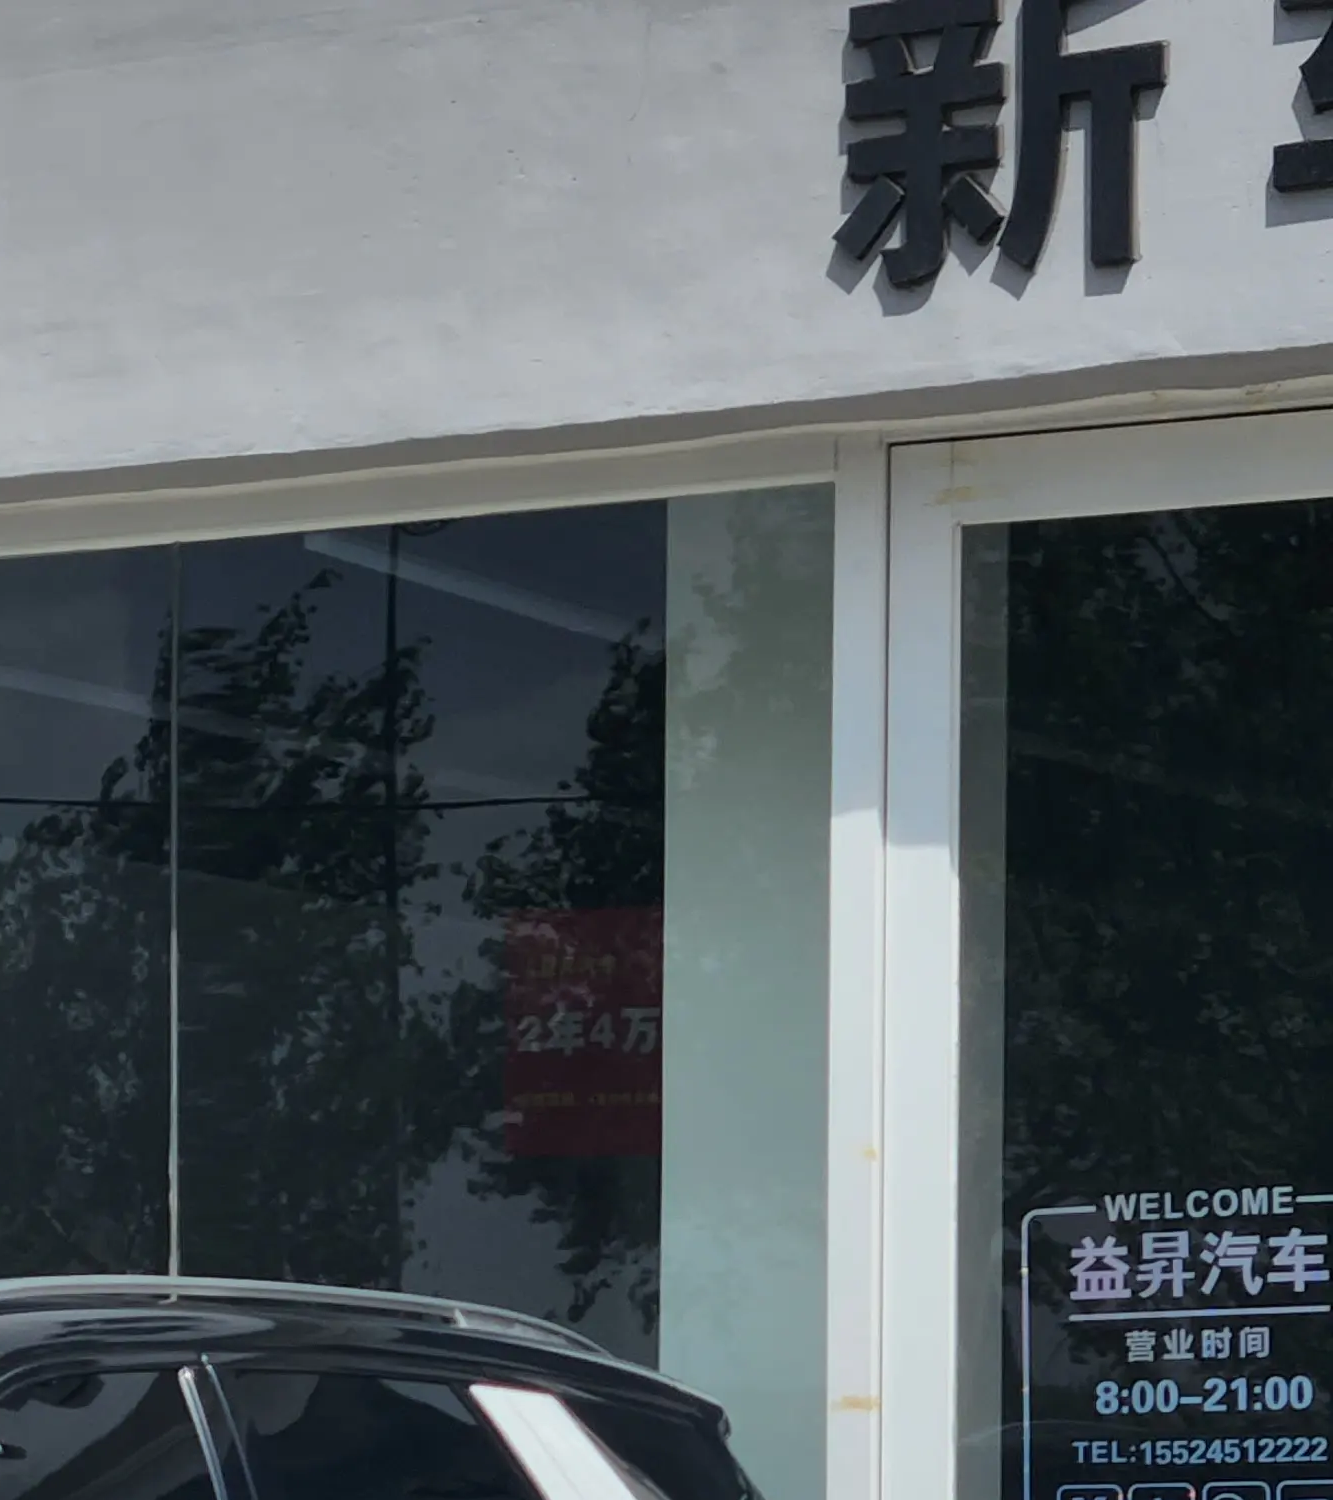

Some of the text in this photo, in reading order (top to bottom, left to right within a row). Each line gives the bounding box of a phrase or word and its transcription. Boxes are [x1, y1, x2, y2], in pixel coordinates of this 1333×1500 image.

[1104, 1186, 1294, 1222] WELCOME
[1069, 1227, 1330, 1300] 益昇汽车
[1125, 1326, 1271, 1363] 营业时间
[1095, 1375, 1313, 1415] 8:00-21:00
[1072, 1437, 1328, 1466] TEL:15524512222
